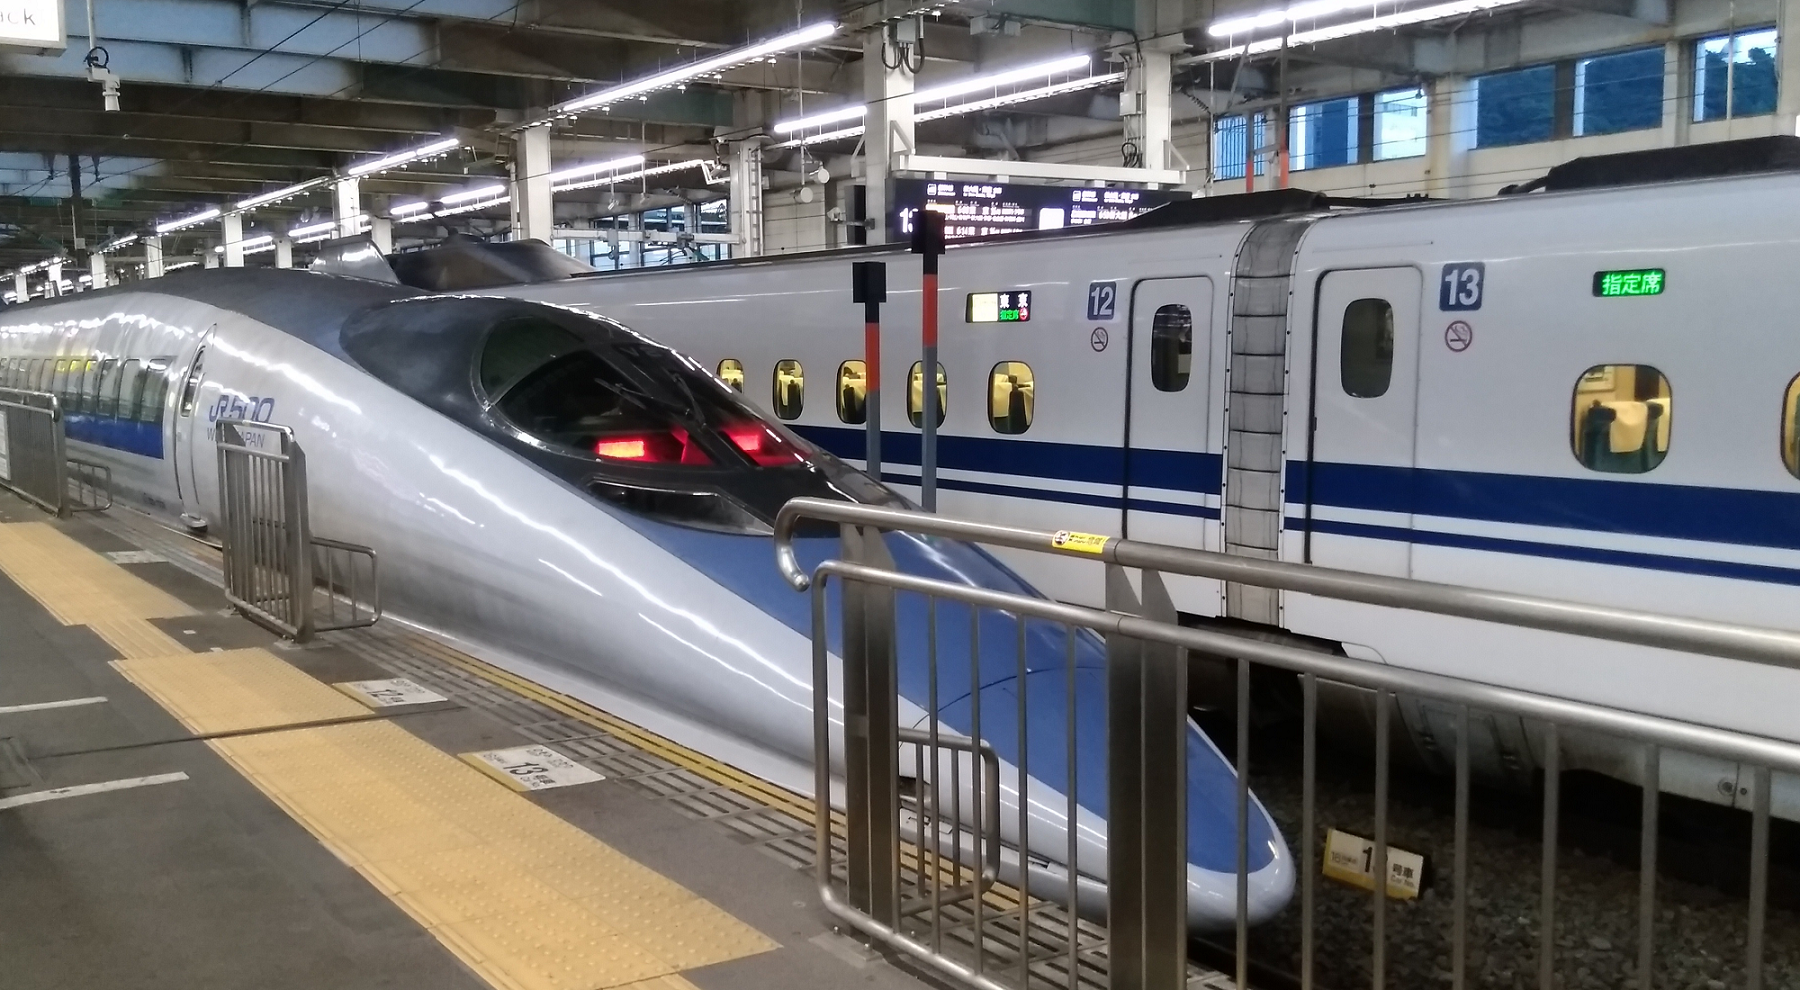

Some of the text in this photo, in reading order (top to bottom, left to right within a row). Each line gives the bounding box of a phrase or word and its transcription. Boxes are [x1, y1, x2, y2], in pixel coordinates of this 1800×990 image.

[1444, 268, 1481, 306] 13
[1602, 272, 1662, 295] 指定席
[1091, 286, 1115, 316] 12
[503, 761, 549, 776] 13
